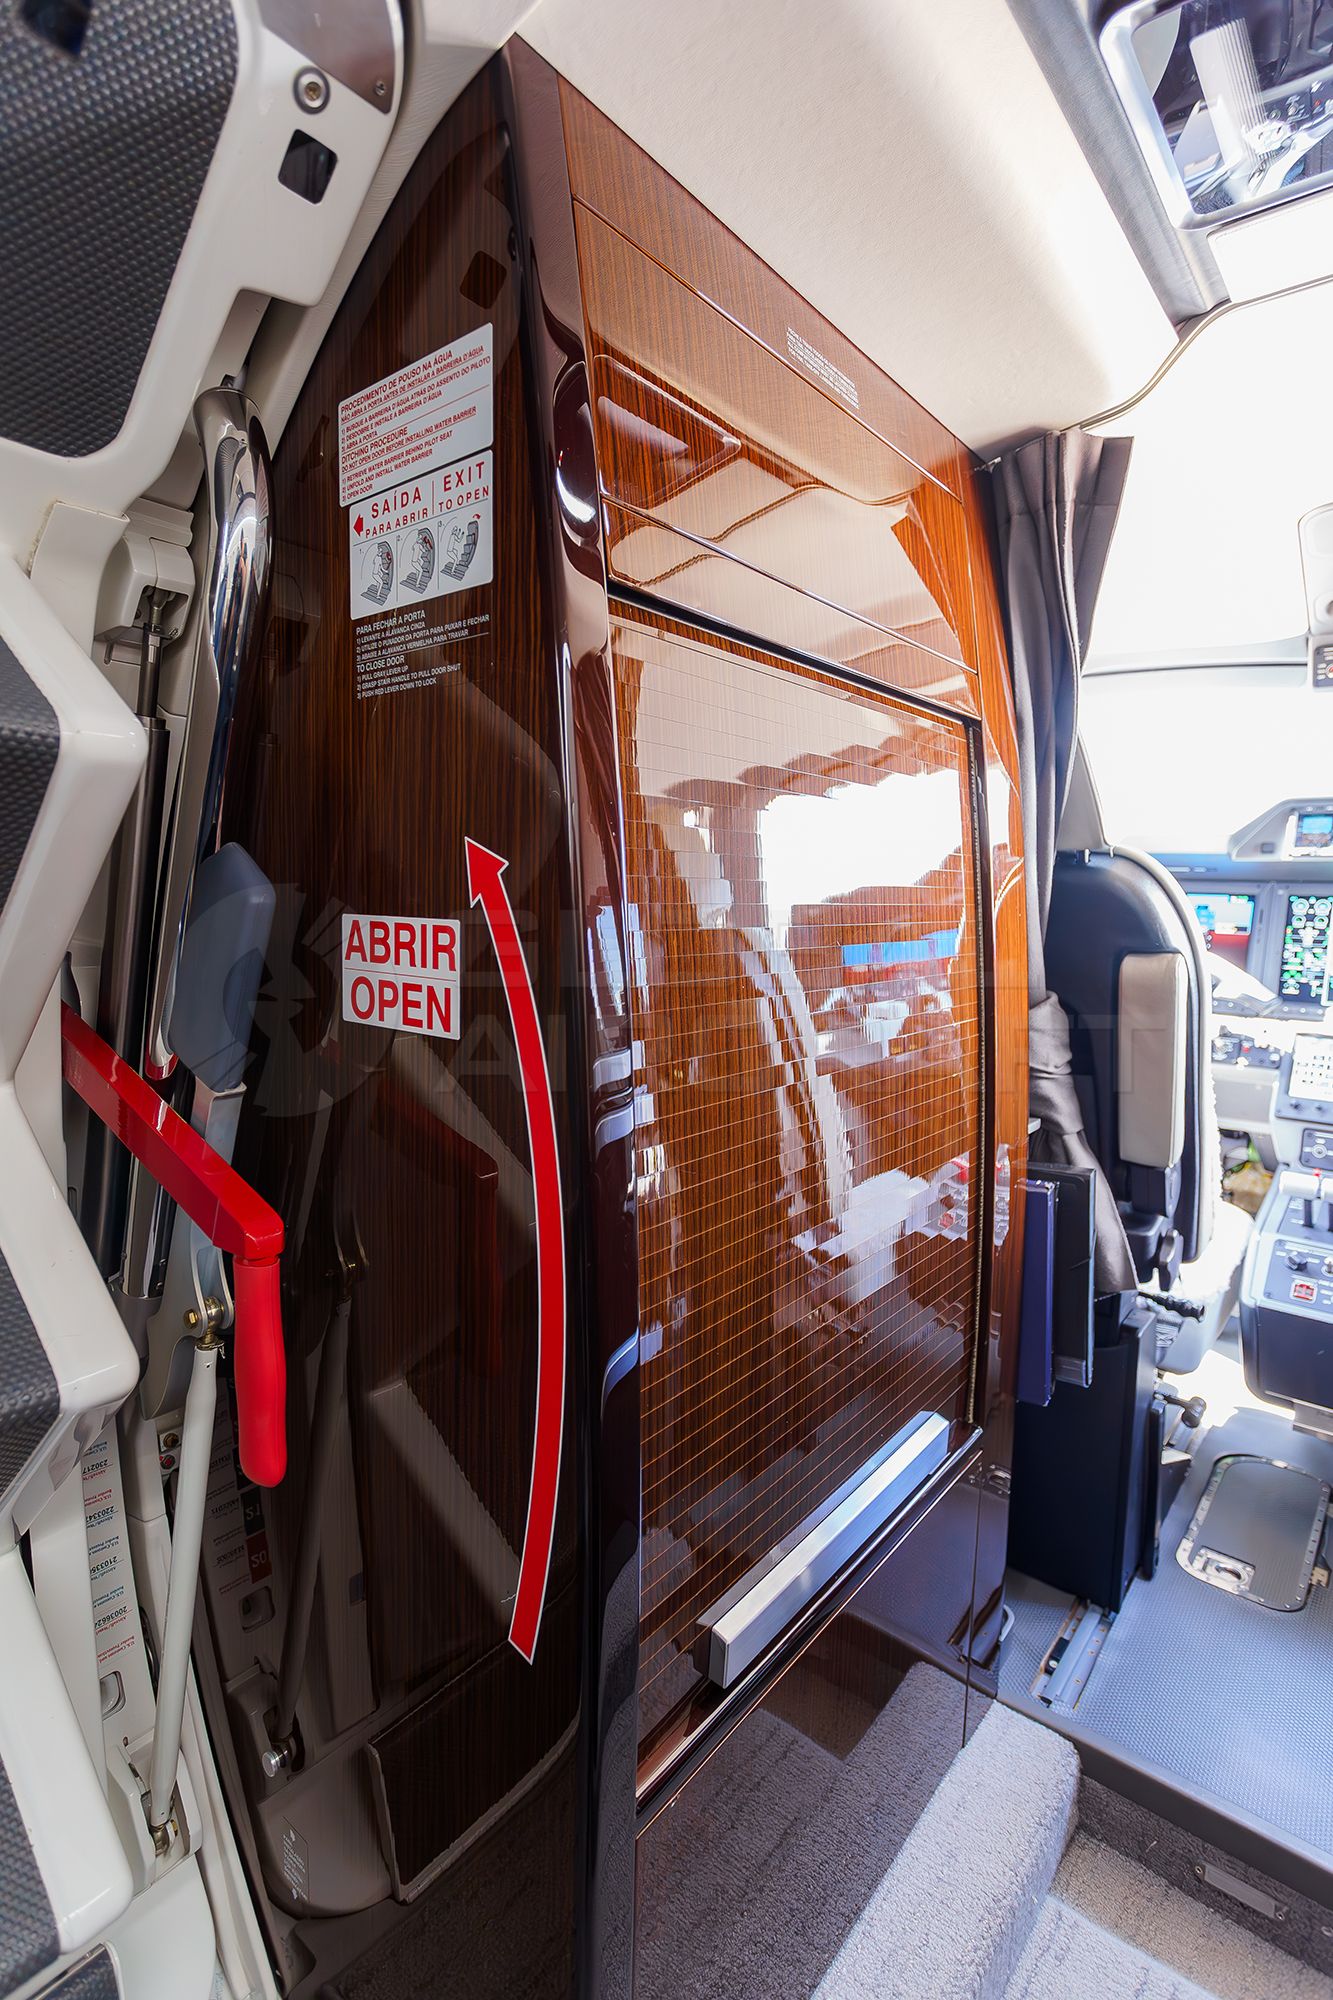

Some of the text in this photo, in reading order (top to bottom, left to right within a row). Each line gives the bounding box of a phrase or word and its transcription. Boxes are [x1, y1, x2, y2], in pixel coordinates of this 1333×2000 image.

[341, 384, 387, 414] PROCEDIMENTO
[399, 367, 420, 384] POUSO
[434, 350, 452, 366] ÁGUA
[346, 419, 364, 432] BUSQUE
[368, 406, 391, 421] BARREIRA
[436, 371, 460, 388] ASSENTO
[471, 356, 490, 371] PILOTO
[351, 408, 362, 417] ABRA
[368, 397, 382, 408] PORTA
[384, 389, 398, 400] ANTES
[407, 373, 430, 388] INSTALAR
[436, 357, 462, 374] BARREIRA
[346, 425, 369, 440] DESDOBRE
[375, 414, 392, 427] INSTALE
[398, 400, 422, 416] BARREIRA
[359, 455, 370, 464] OPEN
[372, 448, 385, 458] DOOR
[386, 439, 404, 452] BEFORE
[405, 426, 433, 443] INSTALLING
[434, 418, 451, 430] WATER
[453, 406, 476, 421] BARRIER
[342, 428, 407, 463] DITCHING PROCEDURE
[347, 440, 358, 449] ABRA
[363, 431, 377, 441] PORTA
[347, 469, 367, 481] RETRIEVE
[368, 462, 383, 472] WATER
[384, 452, 404, 465] BARRIER
[405, 444, 423, 456] BEHIND
[425, 437, 438, 447] PILOT
[439, 431, 452, 441] SEAT
[347, 479, 364, 490] UNFOLD
[376, 466, 393, 478] INSTALL
[395, 459, 410, 469] WATER
[411, 449, 432, 462] BARRIER
[444, 461, 484, 493] EXIT
[347, 490, 359, 499] OPEN
[360, 485, 372, 494] DOOR
[371, 485, 422, 520] SAÍDA
[438, 485, 489, 514] TO OPEN
[365, 507, 428, 540] PARA ABRIR
[356, 624, 372, 634] PARA
[373, 618, 397, 630] FECHAR
[404, 610, 426, 622] PORTA
[361, 633, 380, 642] LEVANTE
[386, 626, 410, 636] ALAVANCA
[410, 622, 425, 630] CINZA
[413, 630, 430, 638] PORTA
[430, 626, 444, 634] PARA
[445, 622, 462, 630] PUXAR
[467, 615, 489, 625] FECHAR
[382, 644, 406, 654] ALAVANCA
[407, 638, 433, 648] VERMELHA
[448, 630, 468, 638] TRAVAR
[362, 681, 377, 689] GRASP
[378, 678, 391, 686] STAIR
[392, 674, 410, 683] HANDLE
[432, 666, 447, 674] DOOR
[447, 663, 460, 671] SHUT
[366, 660, 385, 670] CLOSE
[386, 655, 405, 665] DOOR
[385, 685, 400, 693] LEVER
[400, 682, 415, 690] DOWN
[422, 677, 436, 685] LOCK
[345, 919, 456, 972] ABRIR
[350, 976, 451, 1033] OPEN
[90, 1556, 117, 1575] 210335
